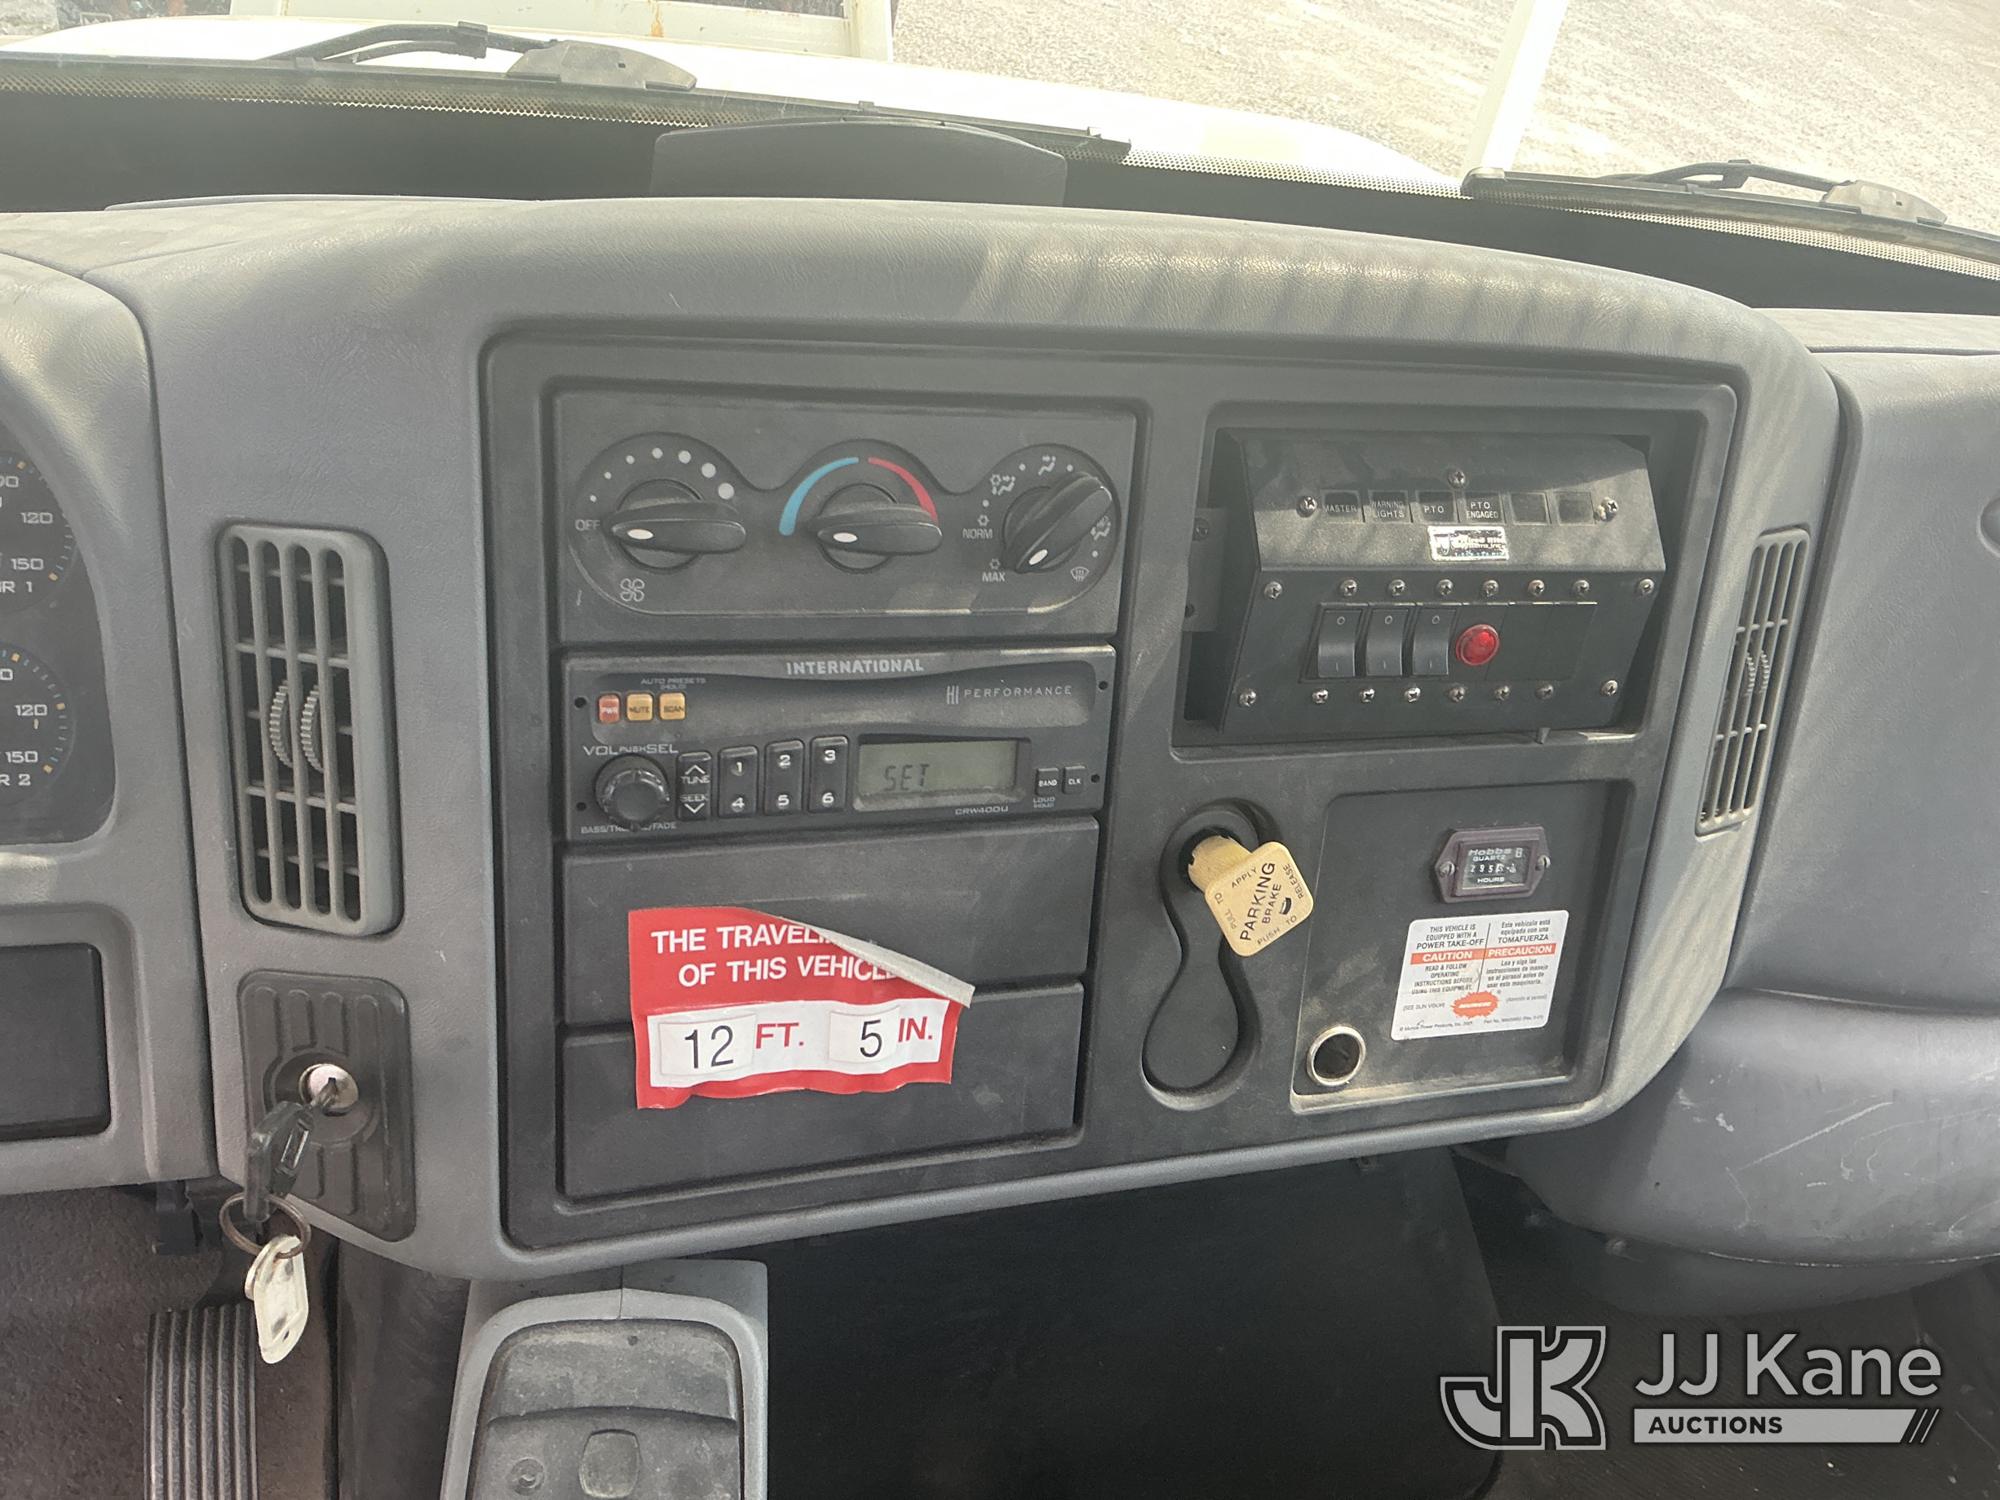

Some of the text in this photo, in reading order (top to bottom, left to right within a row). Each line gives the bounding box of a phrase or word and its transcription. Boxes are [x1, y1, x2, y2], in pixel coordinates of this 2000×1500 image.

[21, 512, 53, 524] 120
[575, 519, 600, 531] OFF
[962, 528, 993, 539] NORM
[11, 558, 44, 570] 150
[982, 571, 1005, 582] MAX
[26, 581, 32, 593] 1
[786, 659, 924, 675] INTERNATIONAL
[964, 686, 1072, 698] PERFORMANCE
[15, 704, 47, 716] 120
[583, 745, 619, 756] VOL
[646, 744, 679, 754] SEL
[824, 750, 836, 761] 3
[5, 751, 38, 763] 150
[779, 755, 791, 767] 2
[735, 762, 743, 773] 1
[18, 774, 31, 786] 2
[681, 776, 710, 784] TUNE
[883, 764, 930, 792] SET
[1039, 779, 1057, 787] BAND
[680, 794, 709, 802] SEEK
[731, 797, 745, 809] 4
[778, 795, 790, 806] 5
[822, 793, 835, 804] 6
[1468, 848, 1512, 856] Hobbs
[1214, 892, 1223, 904] TO
[1231, 867, 1257, 888] APPLY
[1240, 862, 1275, 940] PARKING
[1257, 863, 1304, 945] PUSH TO RELEASE
[1262, 884, 1282, 924] BRAKE
[1445, 924, 1469, 932] VEHICLE
[651, 928, 706, 954] THE
[1426, 933, 1455, 941] EQUIPPED
[1497, 934, 1549, 944] TOMAFUERZA
[1416, 938, 1484, 950] POWER TAKE-OFF
[1422, 951, 1473, 962] CAUTION
[1488, 945, 1553, 957] PRECAUCION
[678, 962, 716, 987] OF
[726, 957, 788, 983] THIS
[1430, 971, 1460, 979] OPERATING
[1414, 979, 1452, 987] INSTRUCTIONS
[684, 1016, 933, 1069] 12 FT. 5 IN.
